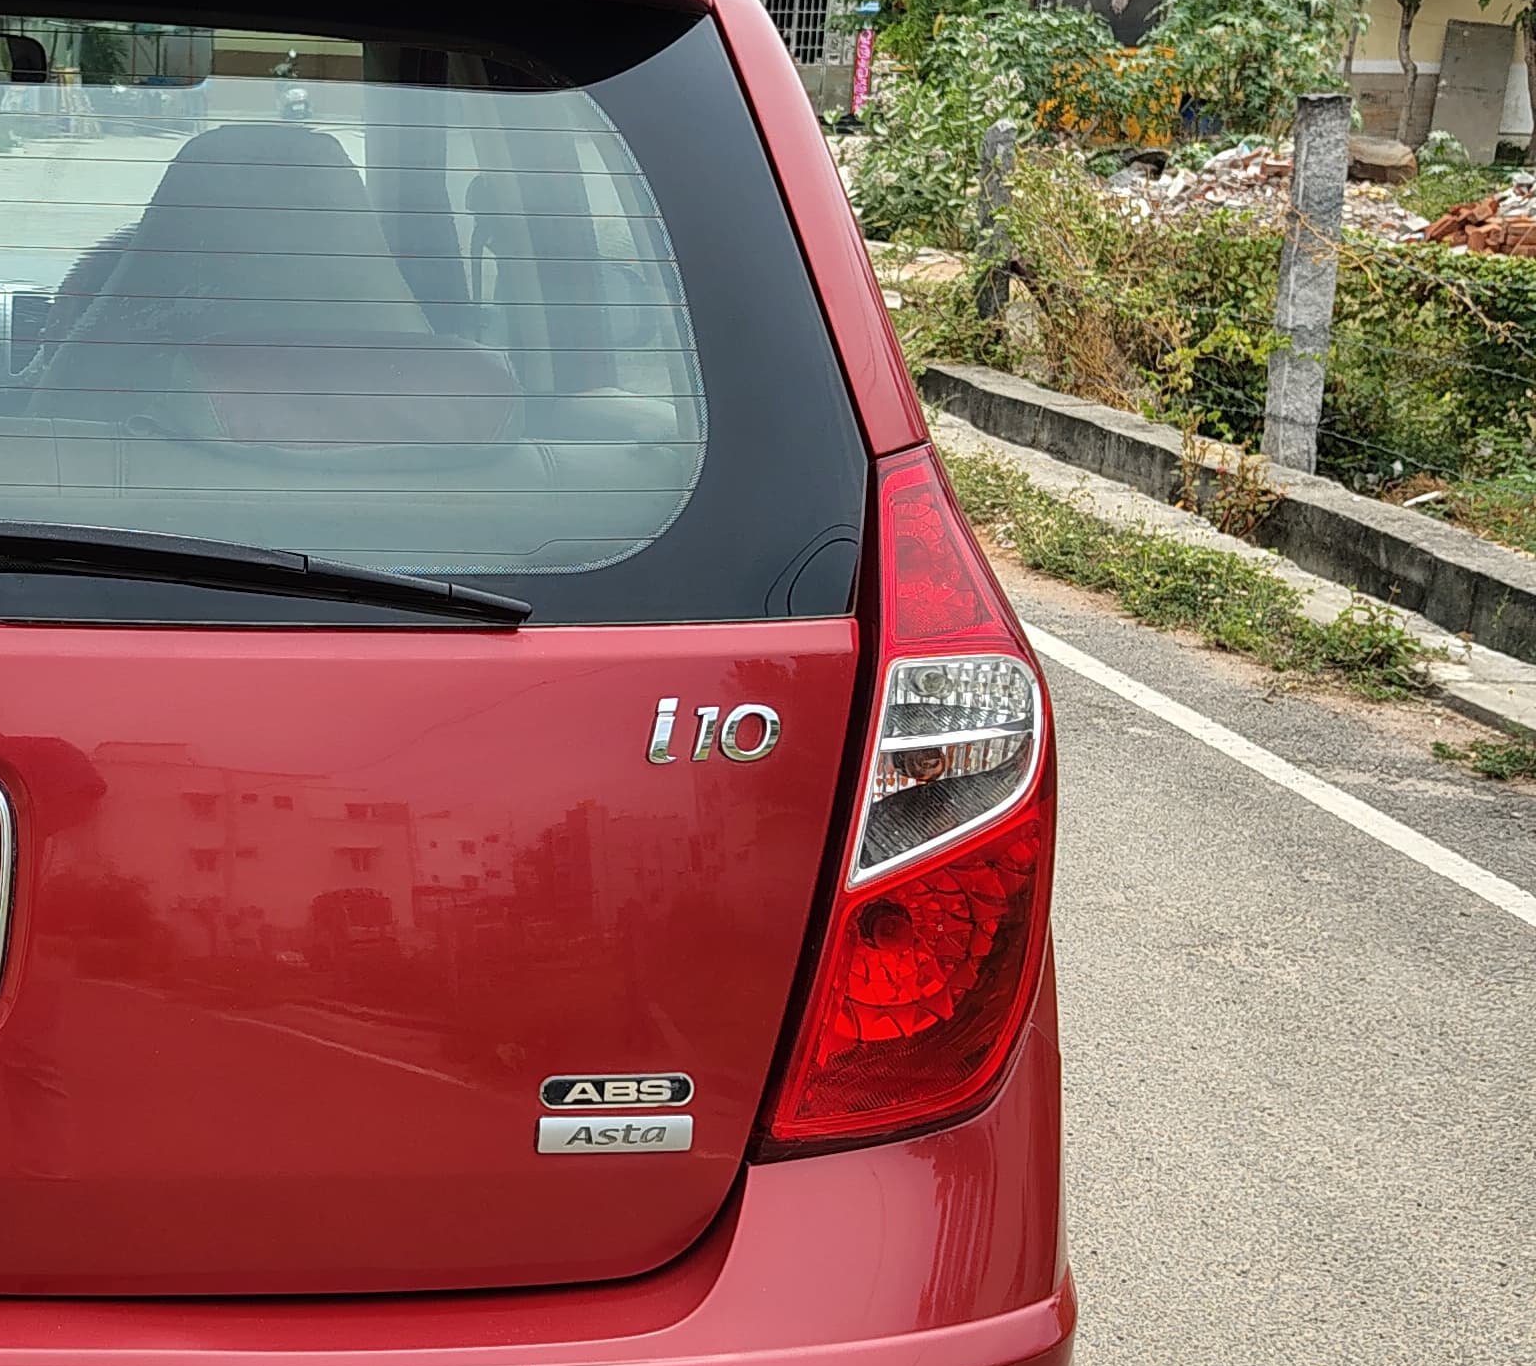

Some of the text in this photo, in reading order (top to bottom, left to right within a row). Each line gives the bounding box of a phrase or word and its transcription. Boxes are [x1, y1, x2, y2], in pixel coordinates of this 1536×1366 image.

[648, 697, 781, 764] i10
[563, 1079, 672, 1103] ABS
[565, 1123, 667, 1146] Asta
